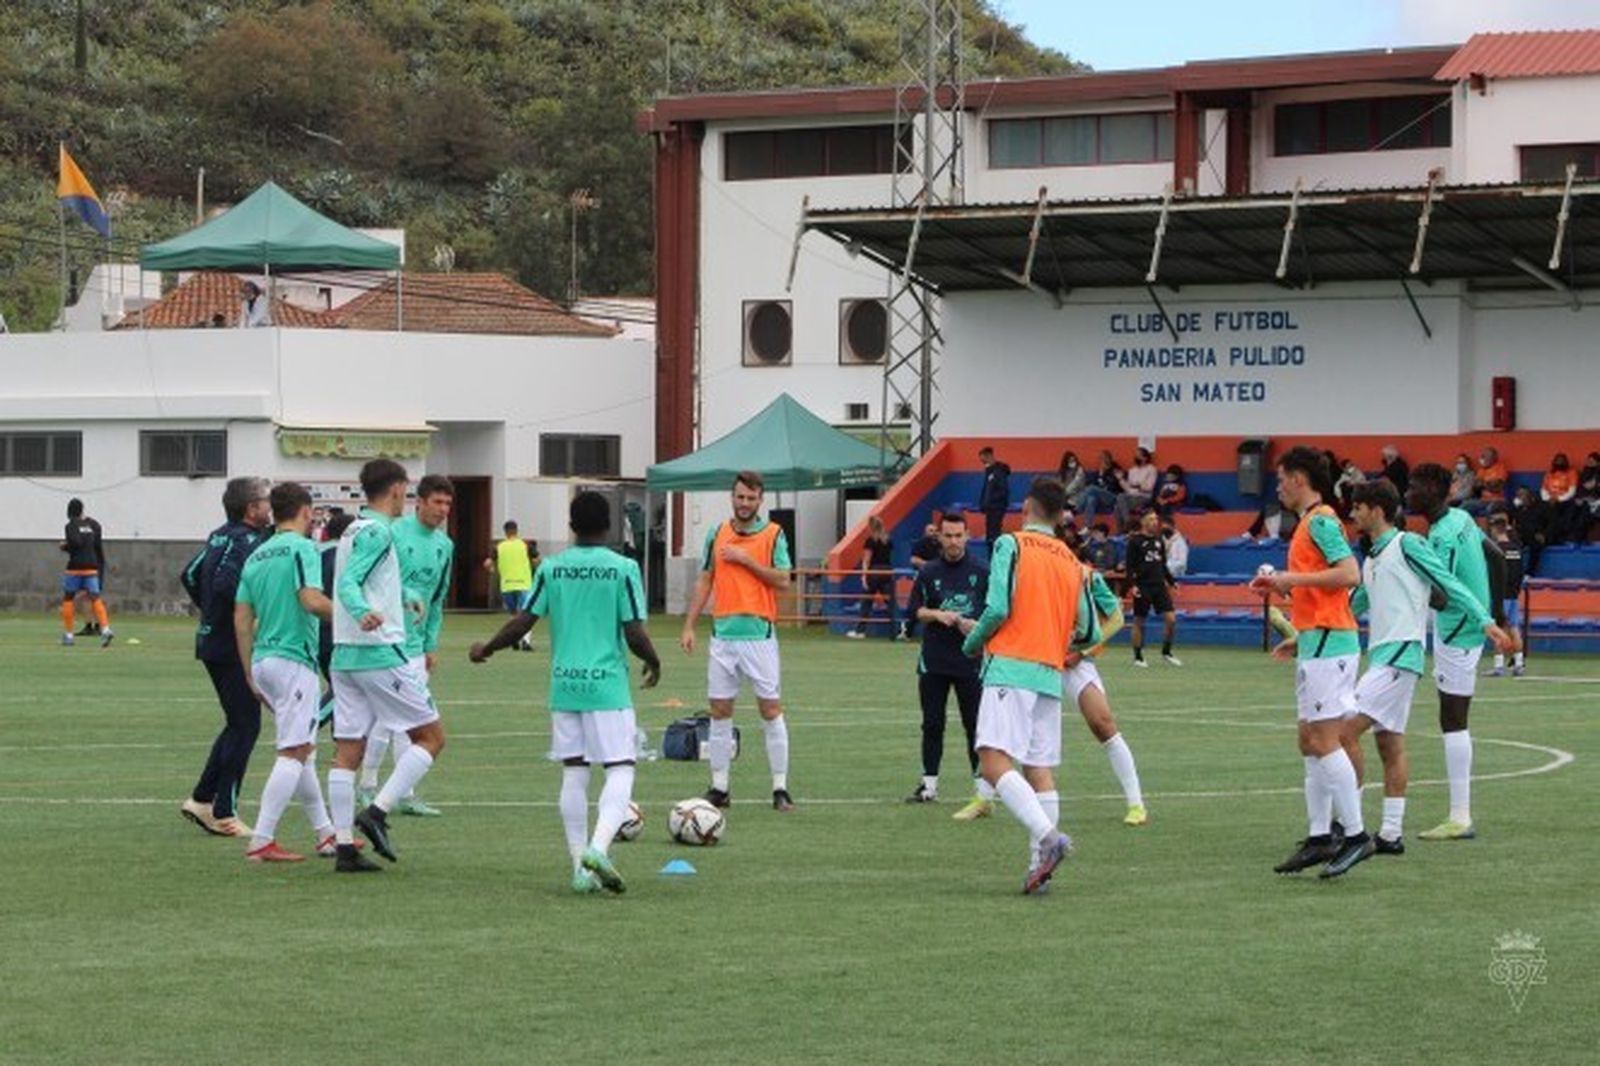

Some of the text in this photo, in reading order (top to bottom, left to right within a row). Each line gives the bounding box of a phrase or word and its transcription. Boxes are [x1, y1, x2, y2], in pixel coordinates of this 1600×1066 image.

[1111, 311, 1299, 333] CLUB DE FUTBOL
[1104, 345, 1305, 368] PANADERIA PULIDO
[1141, 382, 1266, 402] SAN MATEO
[553, 566, 618, 581] macron
